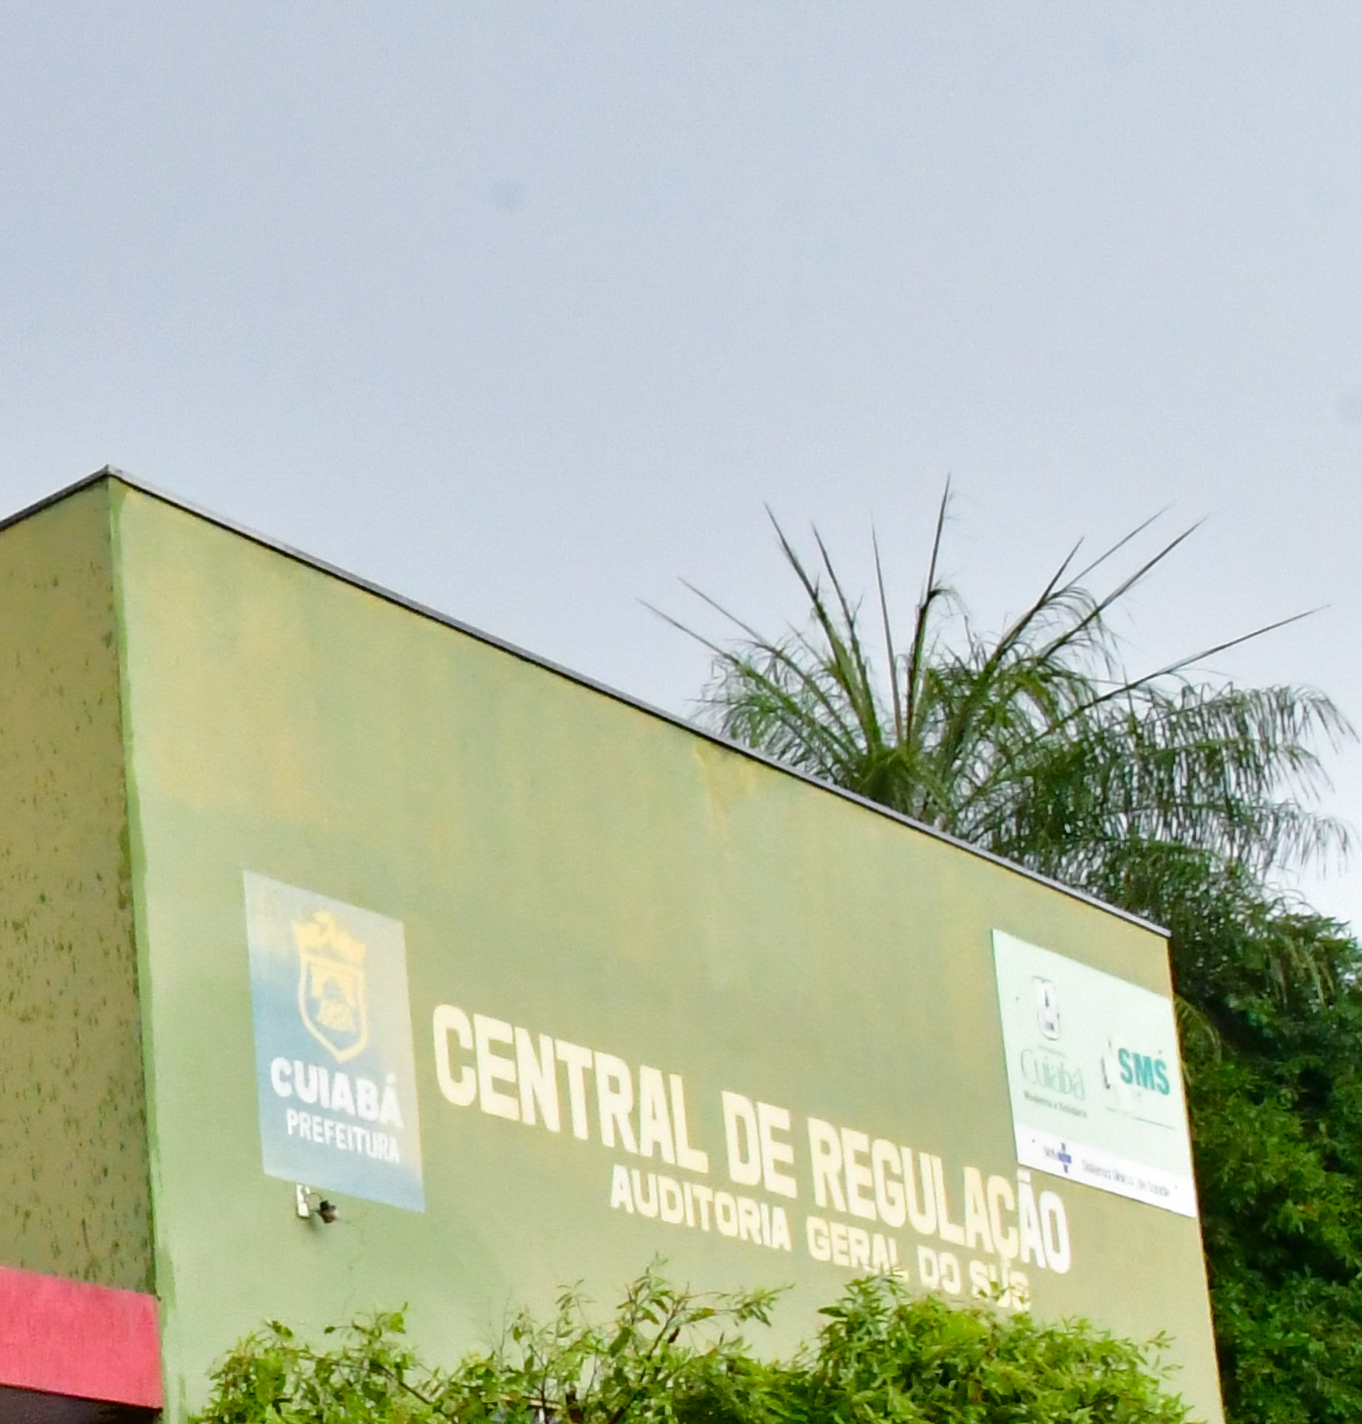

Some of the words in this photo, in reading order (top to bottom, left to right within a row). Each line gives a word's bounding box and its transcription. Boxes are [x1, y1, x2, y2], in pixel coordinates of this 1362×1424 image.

[270, 1056, 404, 1130] CUIABÁ
[1117, 1047, 1171, 1096] SMS
[286, 1108, 401, 1164] PREFEITURA
[432, 1003, 709, 1174] CENTRAL
[721, 1090, 797, 1199] DE
[806, 1115, 1072, 1275] REGULAÇÃO
[610, 1164, 792, 1252] AUDITORIA
[805, 1215, 910, 1284] GERAL
[916, 1244, 962, 1295] DO
